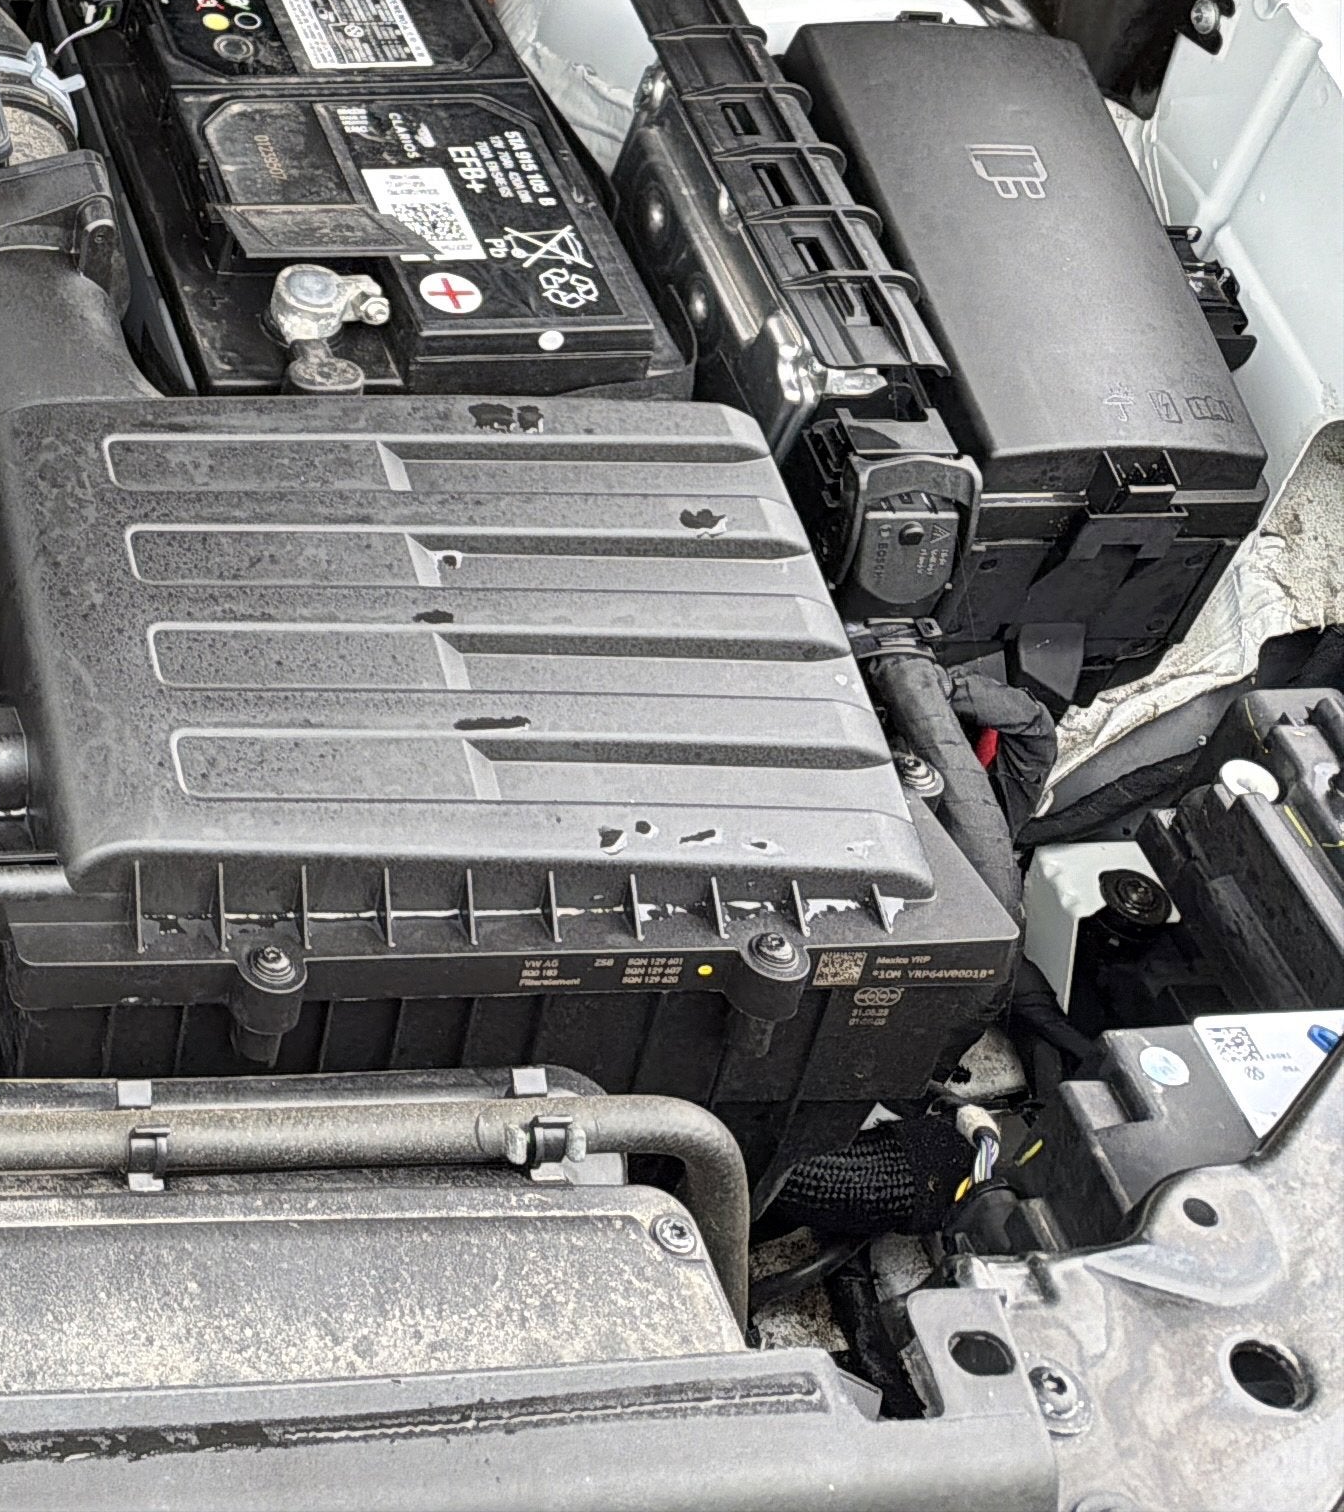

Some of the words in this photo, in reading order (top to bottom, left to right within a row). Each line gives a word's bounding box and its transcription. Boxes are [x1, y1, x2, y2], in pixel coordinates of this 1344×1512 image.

[388, 113, 421, 159] CLARIOS
[448, 146, 488, 193] EFB+
[515, 151, 539, 172] 915
[484, 239, 509, 258] Pb
[524, 959, 541, 968] VW
[543, 958, 559, 968] AG
[876, 955, 910, 965] Mexico
